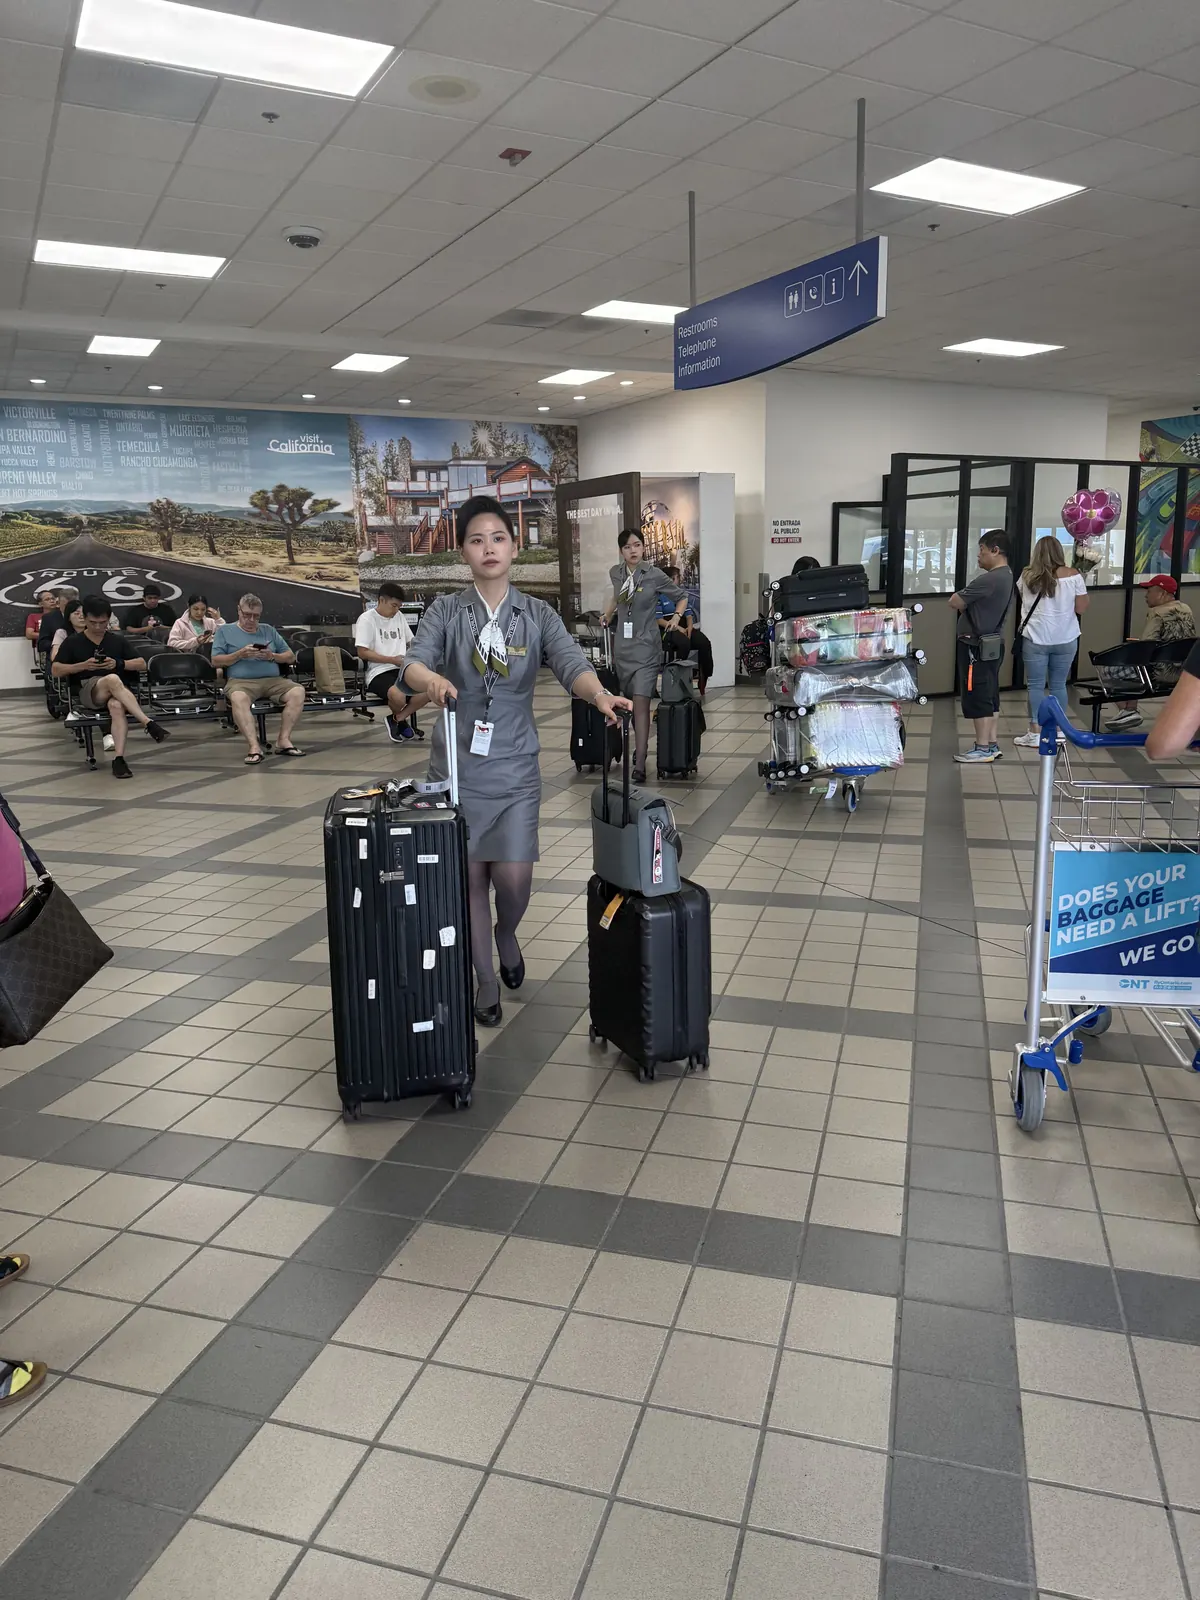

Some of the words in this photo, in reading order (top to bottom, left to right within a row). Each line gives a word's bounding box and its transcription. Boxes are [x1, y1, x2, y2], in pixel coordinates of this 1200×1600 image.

[678, 316, 718, 339] Restrooms
[678, 336, 716, 358] Telephone
[678, 355, 720, 377] Information
[2, 406, 57, 420] VICTORVILLE
[116, 422, 143, 433] ONTARIO
[169, 424, 210, 438] MURRIETA
[212, 424, 247, 435] HESPERIA
[6, 429, 67, 443] BERNARDINO
[300, 434, 320, 443] visit
[12, 445, 36, 455] VALLEY
[116, 440, 160, 453] TEMECULA
[268, 439, 334, 454] California
[20, 459, 38, 467] VALLEY
[60, 457, 96, 468] BARSTOW
[120, 456, 152, 467] RANCHO
[152, 456, 198, 468] CUCAMONGA
[26, 470, 57, 484] VALLEY
[28, 489, 58, 498] SPRINGS
[566, 510, 576, 520] THE
[578, 509, 590, 518] BEST
[590, 508, 602, 516] DAY
[40, 570, 139, 578] ROUTE
[1058, 882, 1118, 912] DOES
[1124, 864, 1186, 894] YOUR
[1058, 887, 1164, 928] BAGGAGE
[1056, 918, 1116, 946] NEED
[1121, 913, 1138, 930] A
[1144, 894, 1200, 924] LIFT?
[1119, 944, 1156, 967] WE
[1162, 935, 1194, 956] GO
[1119, 979, 1150, 989] ONT
